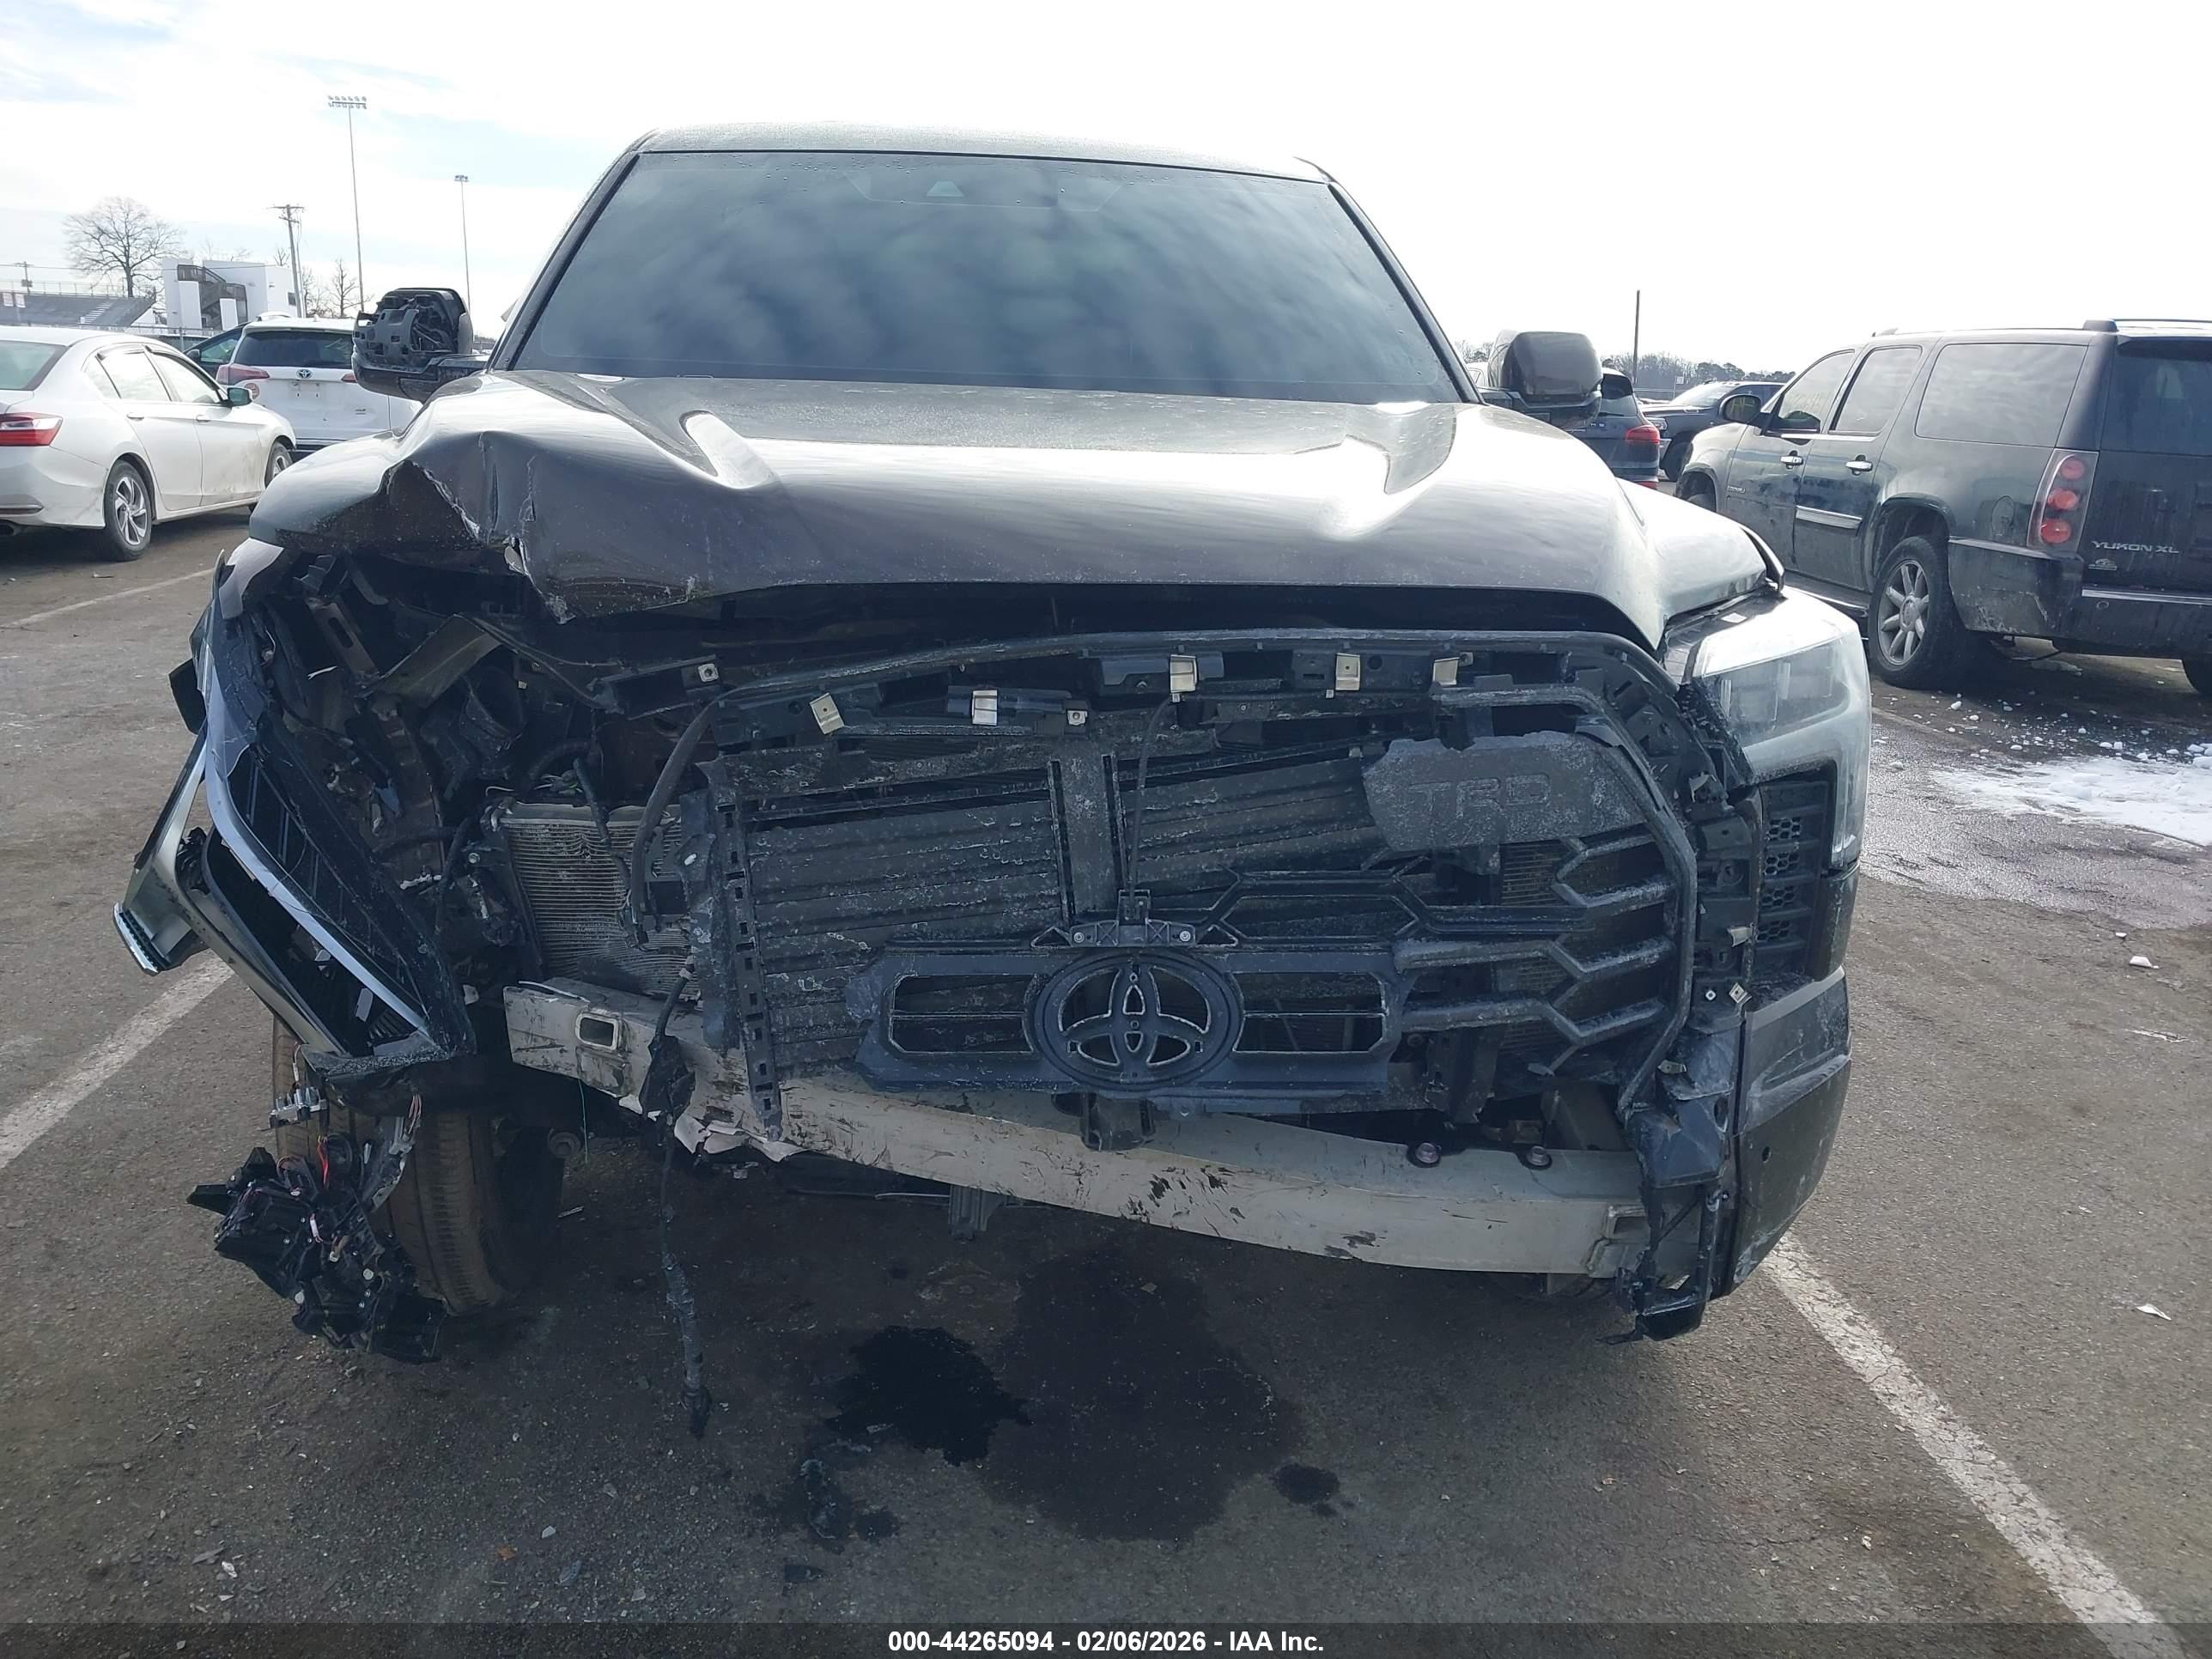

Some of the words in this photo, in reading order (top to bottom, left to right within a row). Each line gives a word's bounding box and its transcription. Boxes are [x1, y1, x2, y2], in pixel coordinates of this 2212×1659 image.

[2092, 540, 2152, 552] YUKON
[2154, 544, 2179, 554] XL
[1408, 773, 1553, 819] TRD
